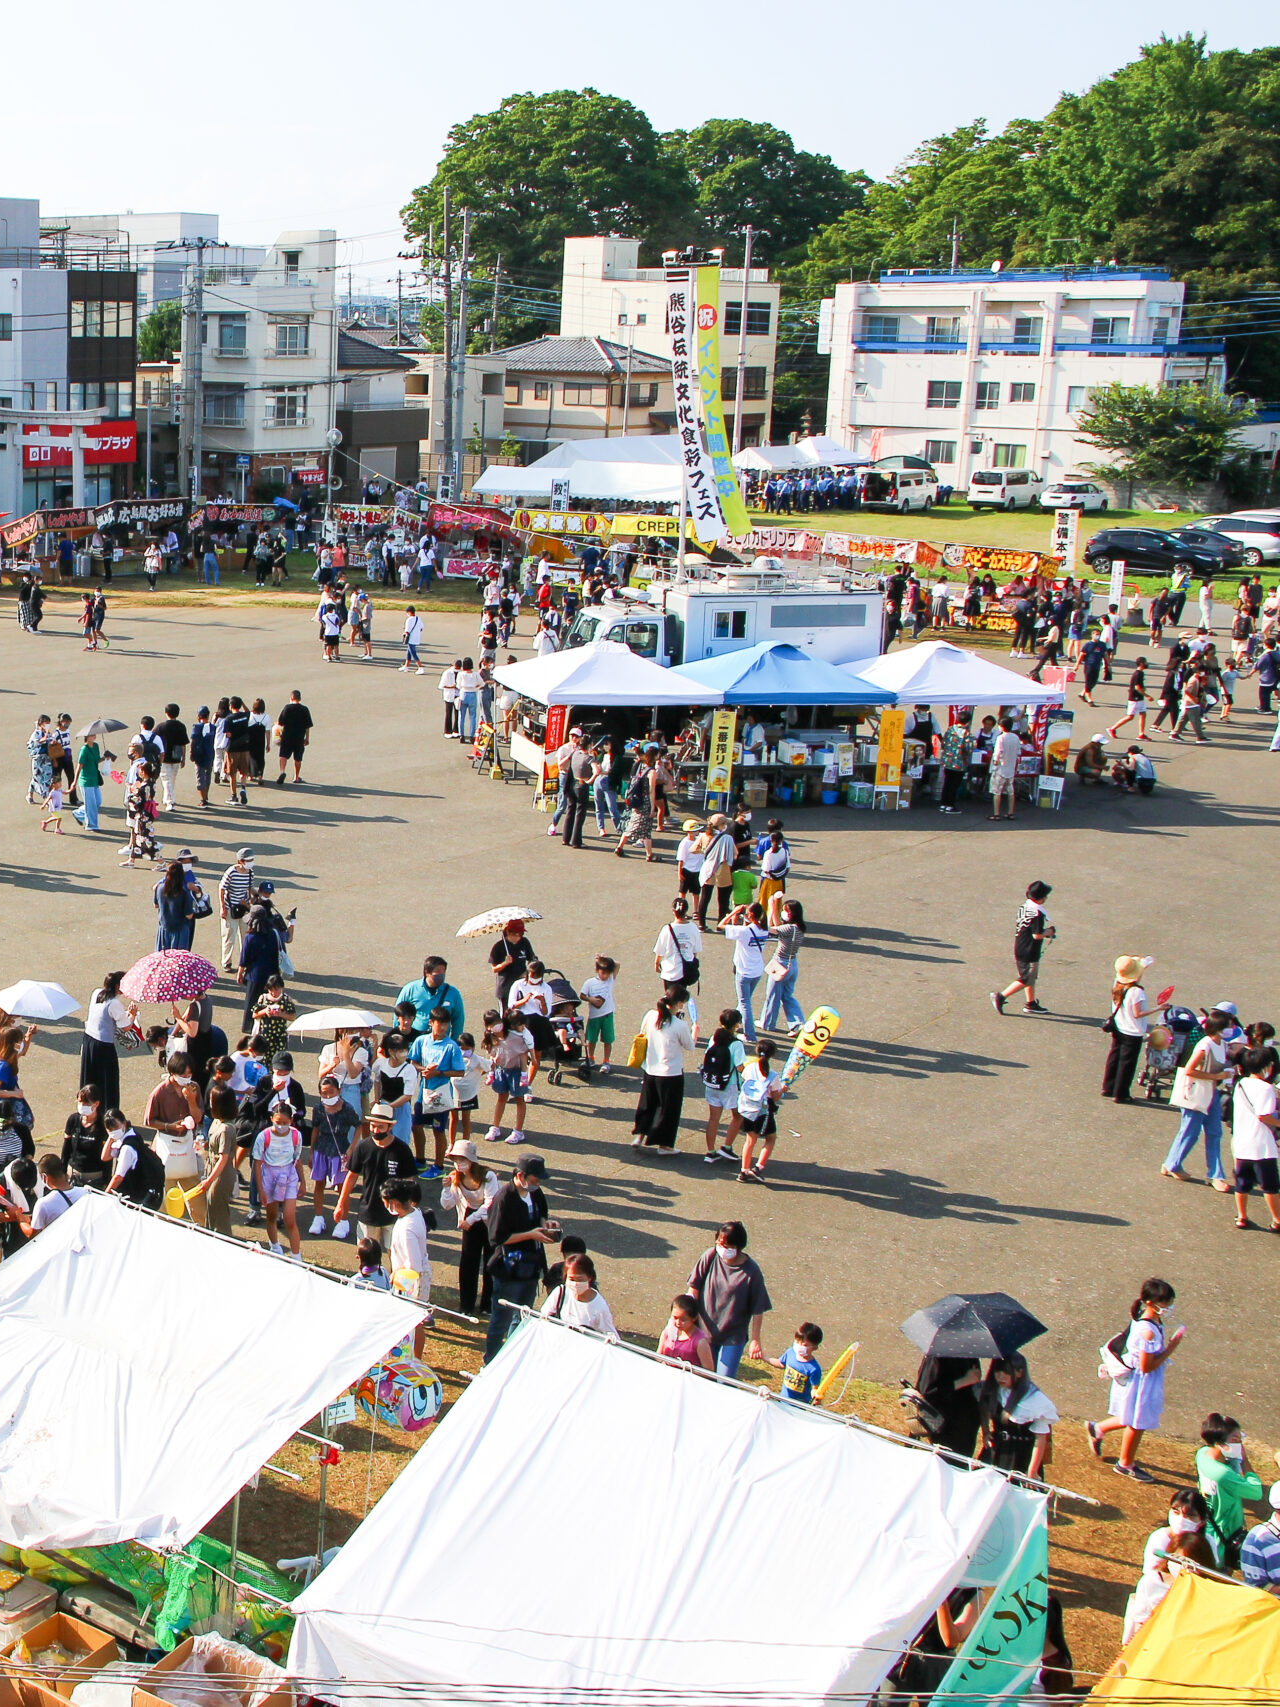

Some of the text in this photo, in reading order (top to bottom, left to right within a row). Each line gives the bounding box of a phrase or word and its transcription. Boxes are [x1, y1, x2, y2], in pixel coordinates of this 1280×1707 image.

[698, 307, 715, 328] 祝
[669, 292, 716, 521] 熊谷伝統文化食彩フェス
[700, 339, 736, 498] イベント開催中
[965, 551, 1023, 571] ベビーカステラ
[716, 725, 729, 764] 一番搾り
